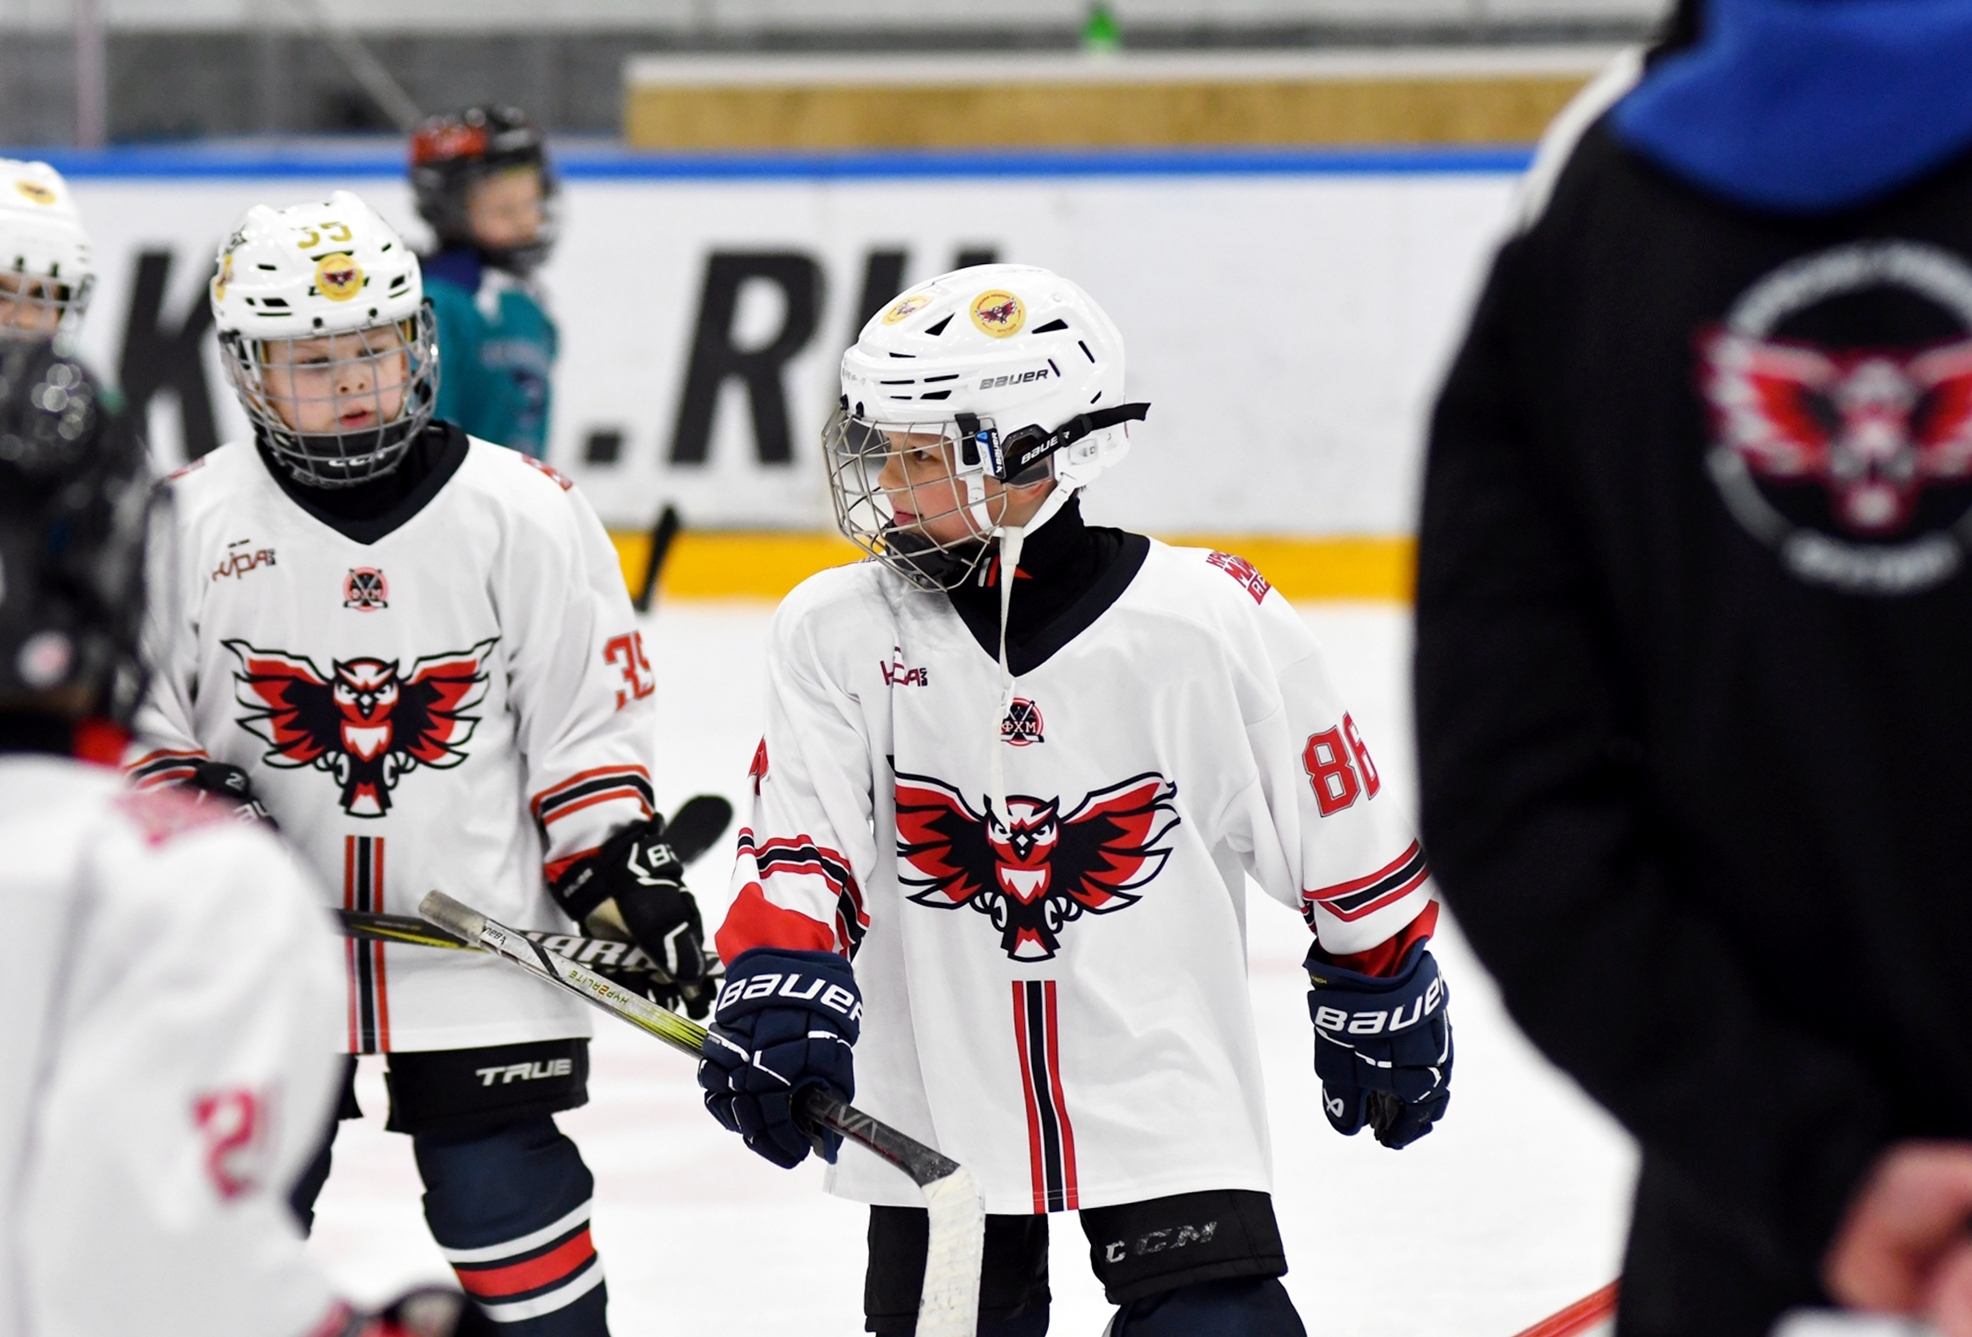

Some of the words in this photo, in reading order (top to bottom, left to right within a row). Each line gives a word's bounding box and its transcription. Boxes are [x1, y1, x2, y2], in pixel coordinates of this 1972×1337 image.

[979, 369, 1049, 390] BAUER
[1001, 721, 1037, 733] ФХМ
[1302, 710, 1381, 818] 86
[475, 1058, 572, 1086] TRUE
